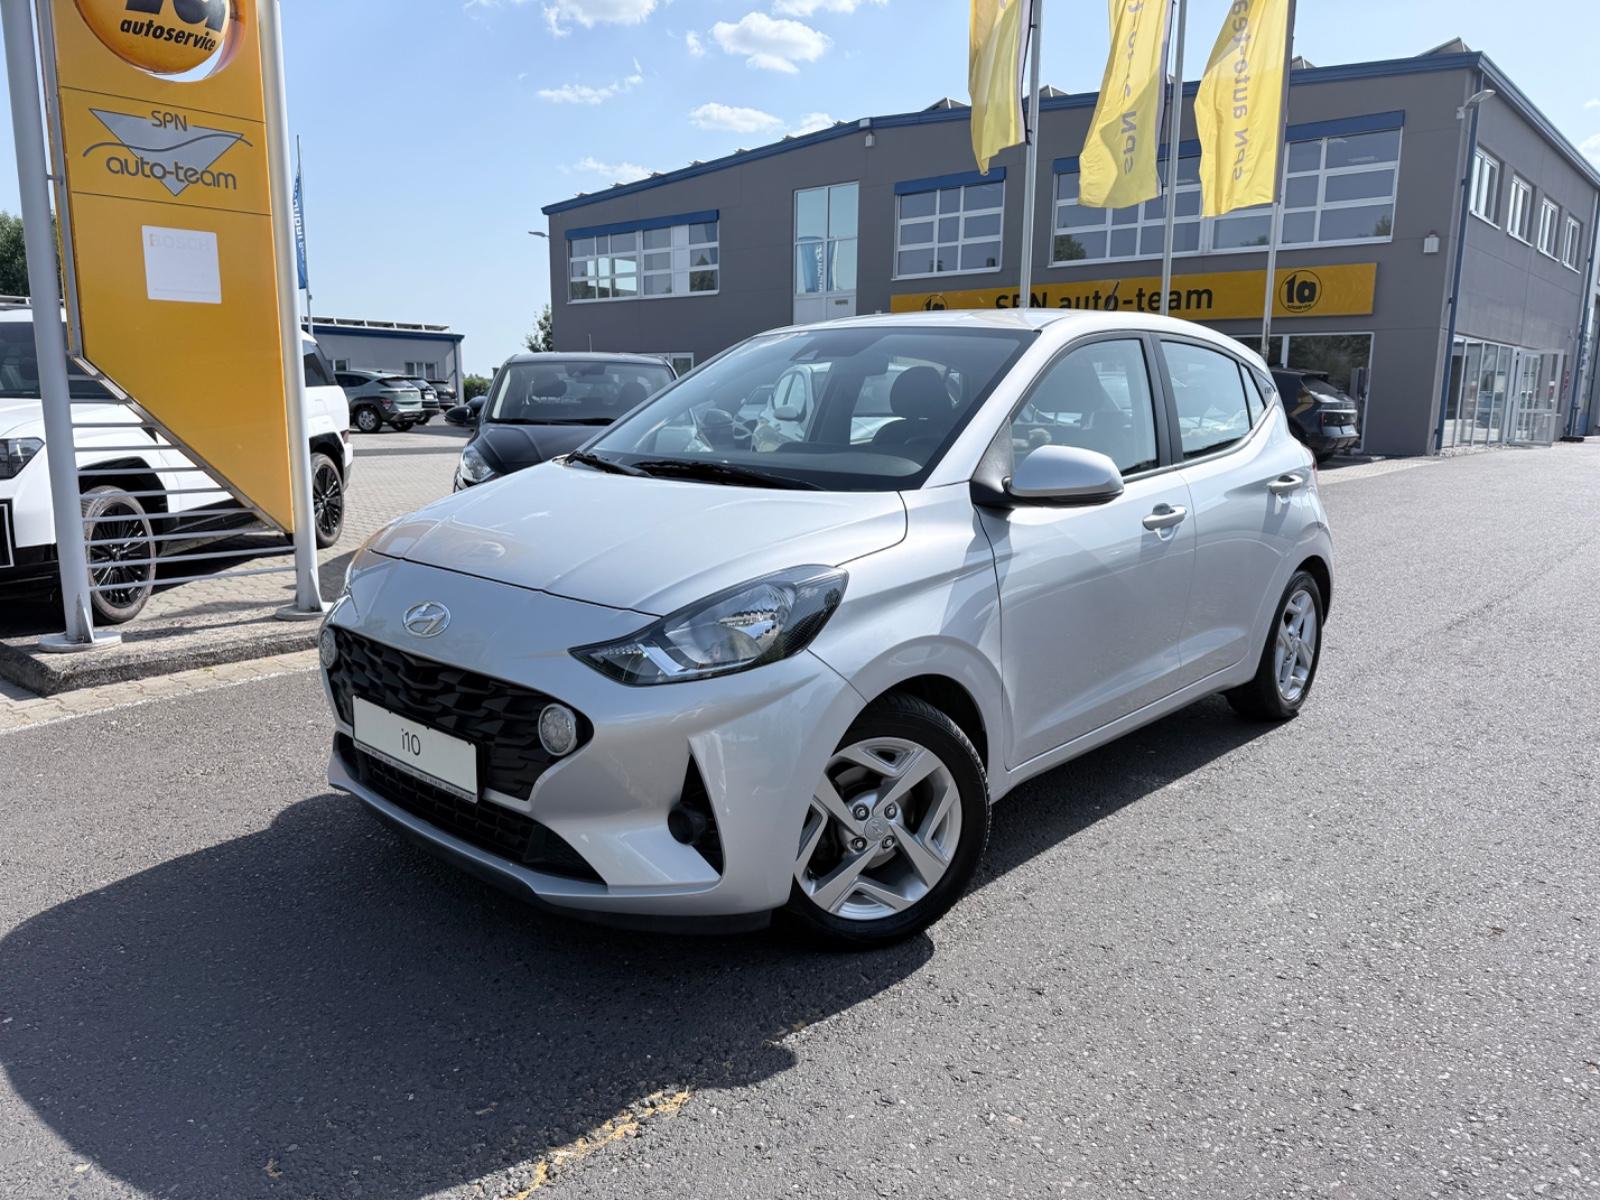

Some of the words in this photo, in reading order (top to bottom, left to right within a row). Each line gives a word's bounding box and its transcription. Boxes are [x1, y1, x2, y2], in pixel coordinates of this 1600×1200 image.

[120, 19, 216, 51] autoservice
[151, 110, 188, 132] SPN
[106, 156, 237, 190] auto-team
[401, 728, 421, 756] i10
